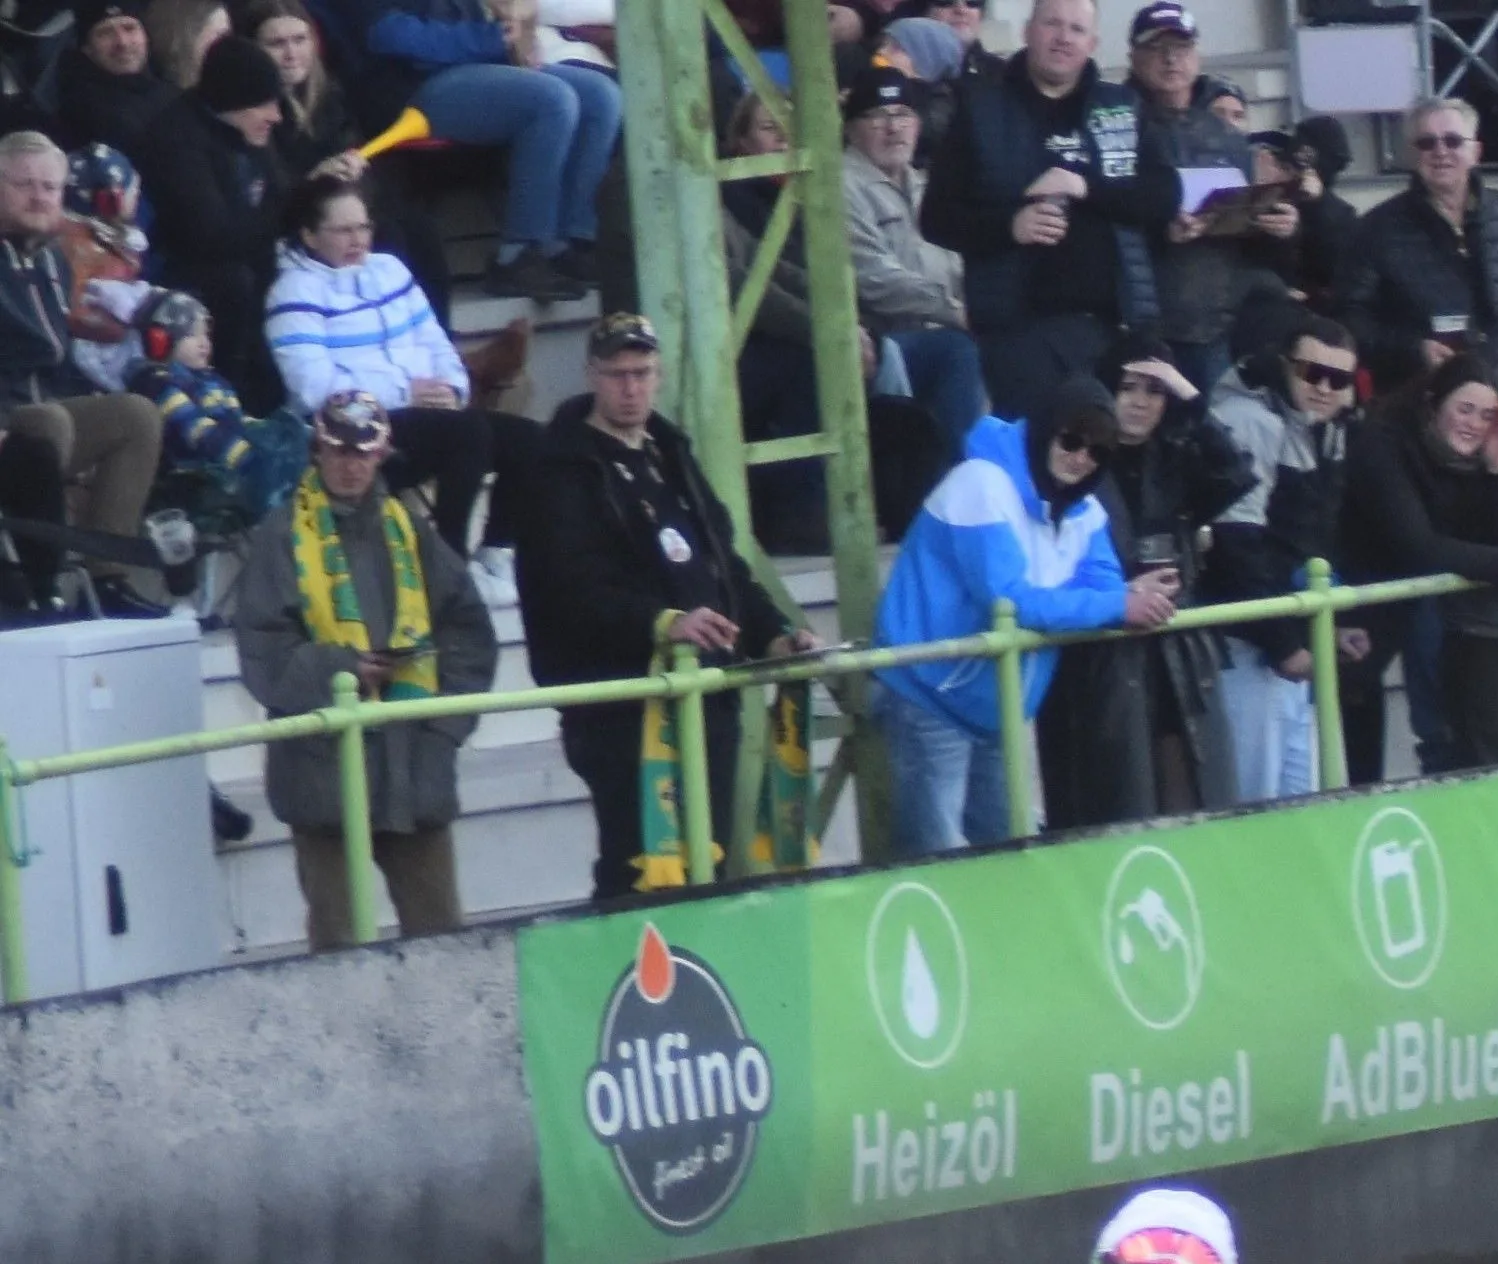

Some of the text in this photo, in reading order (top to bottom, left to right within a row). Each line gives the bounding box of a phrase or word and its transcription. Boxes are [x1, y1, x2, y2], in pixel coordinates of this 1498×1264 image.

[586, 1032, 770, 1137] oilfino
[1090, 1050, 1252, 1164] Diesel
[852, 1089, 1018, 1203] Heizöl
